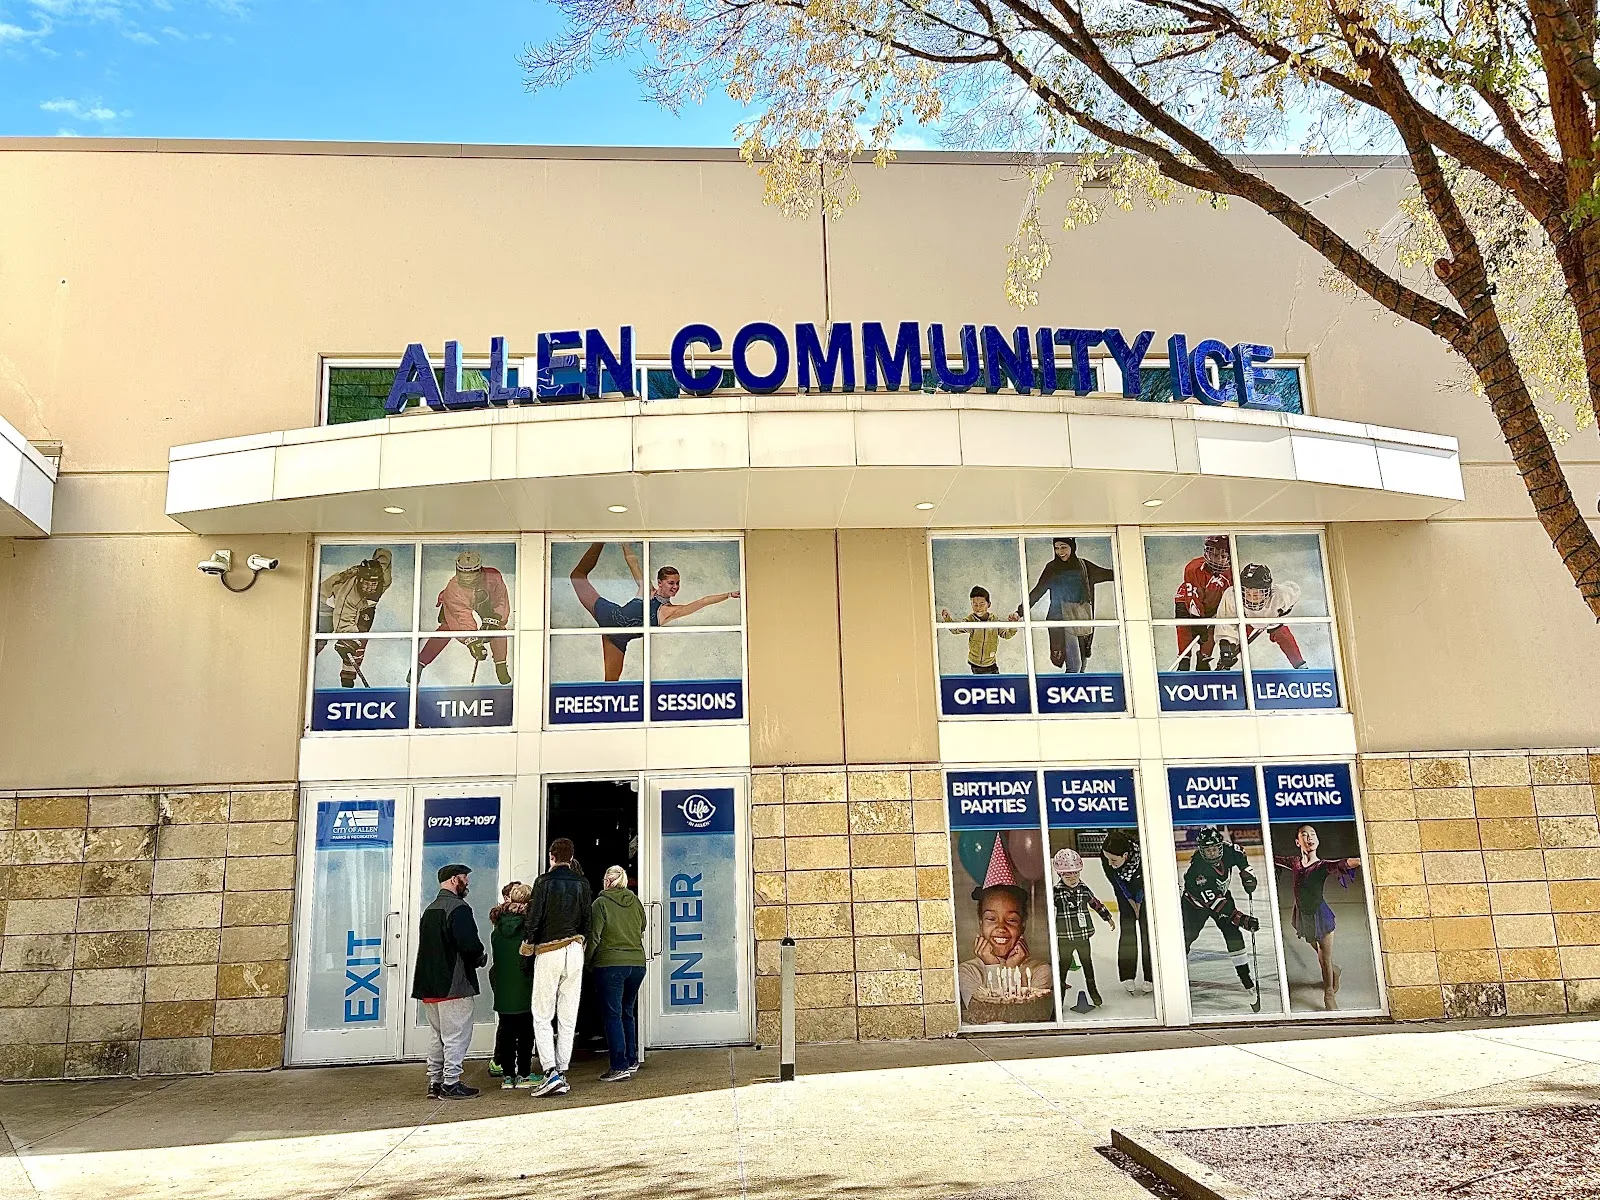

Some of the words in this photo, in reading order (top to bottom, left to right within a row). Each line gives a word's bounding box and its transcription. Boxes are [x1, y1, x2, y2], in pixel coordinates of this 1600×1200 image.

[384, 325, 640, 413] ALLEN
[671, 321, 1156, 398] COMMUNITY
[1168, 333, 1283, 411] ICE
[953, 687, 1016, 705] OPEN
[1046, 686, 1115, 704] SKATE
[1164, 684, 1238, 702] YOUTH
[1256, 681, 1333, 701] LEAGUES
[327, 701, 397, 721] STICK
[437, 699, 495, 719] TIME
[555, 694, 639, 714] FREESTYLE
[657, 692, 737, 712] SESSIONS
[952, 780, 1033, 797] BIRTHDAY
[1062, 779, 1116, 795] LEARN
[1185, 776, 1239, 792] ADULT
[1277, 773, 1336, 790] FIGURE
[960, 798, 1027, 815] PARTIES
[1051, 797, 1075, 812] TO
[1077, 796, 1129, 812] SKATE
[1177, 792, 1251, 810] LEAGUES
[1274, 789, 1342, 807] SKATING
[688, 800, 710, 819] life
[428, 815, 453, 828] (972)
[454, 815, 497, 826] 912-1097
[1200, 889, 1216, 904] 15
[669, 873, 704, 1005] ENTER
[344, 930, 382, 1023] EXIT
